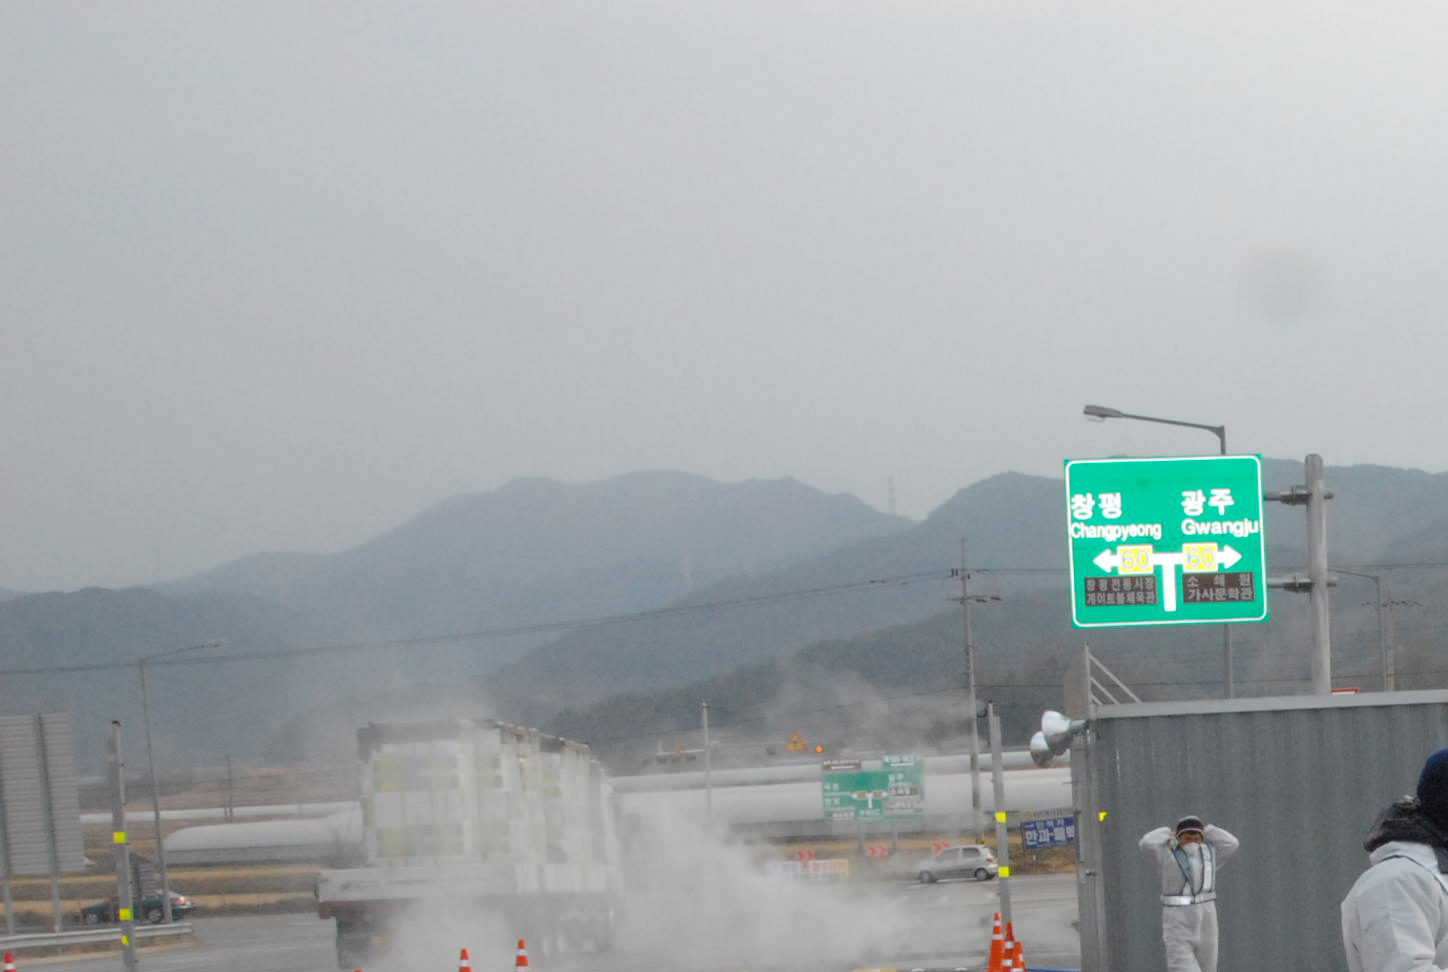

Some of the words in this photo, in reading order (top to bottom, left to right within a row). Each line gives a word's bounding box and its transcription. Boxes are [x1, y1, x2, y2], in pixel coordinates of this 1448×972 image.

[1071, 492, 1123, 520] 창평
[1181, 488, 1235, 516] 광주
[1070, 522, 1162, 542] Changpyeong
[1181, 518, 1259, 538] Gwangju
[1121, 550, 1149, 570] 60
[1187, 548, 1215, 569] 60
